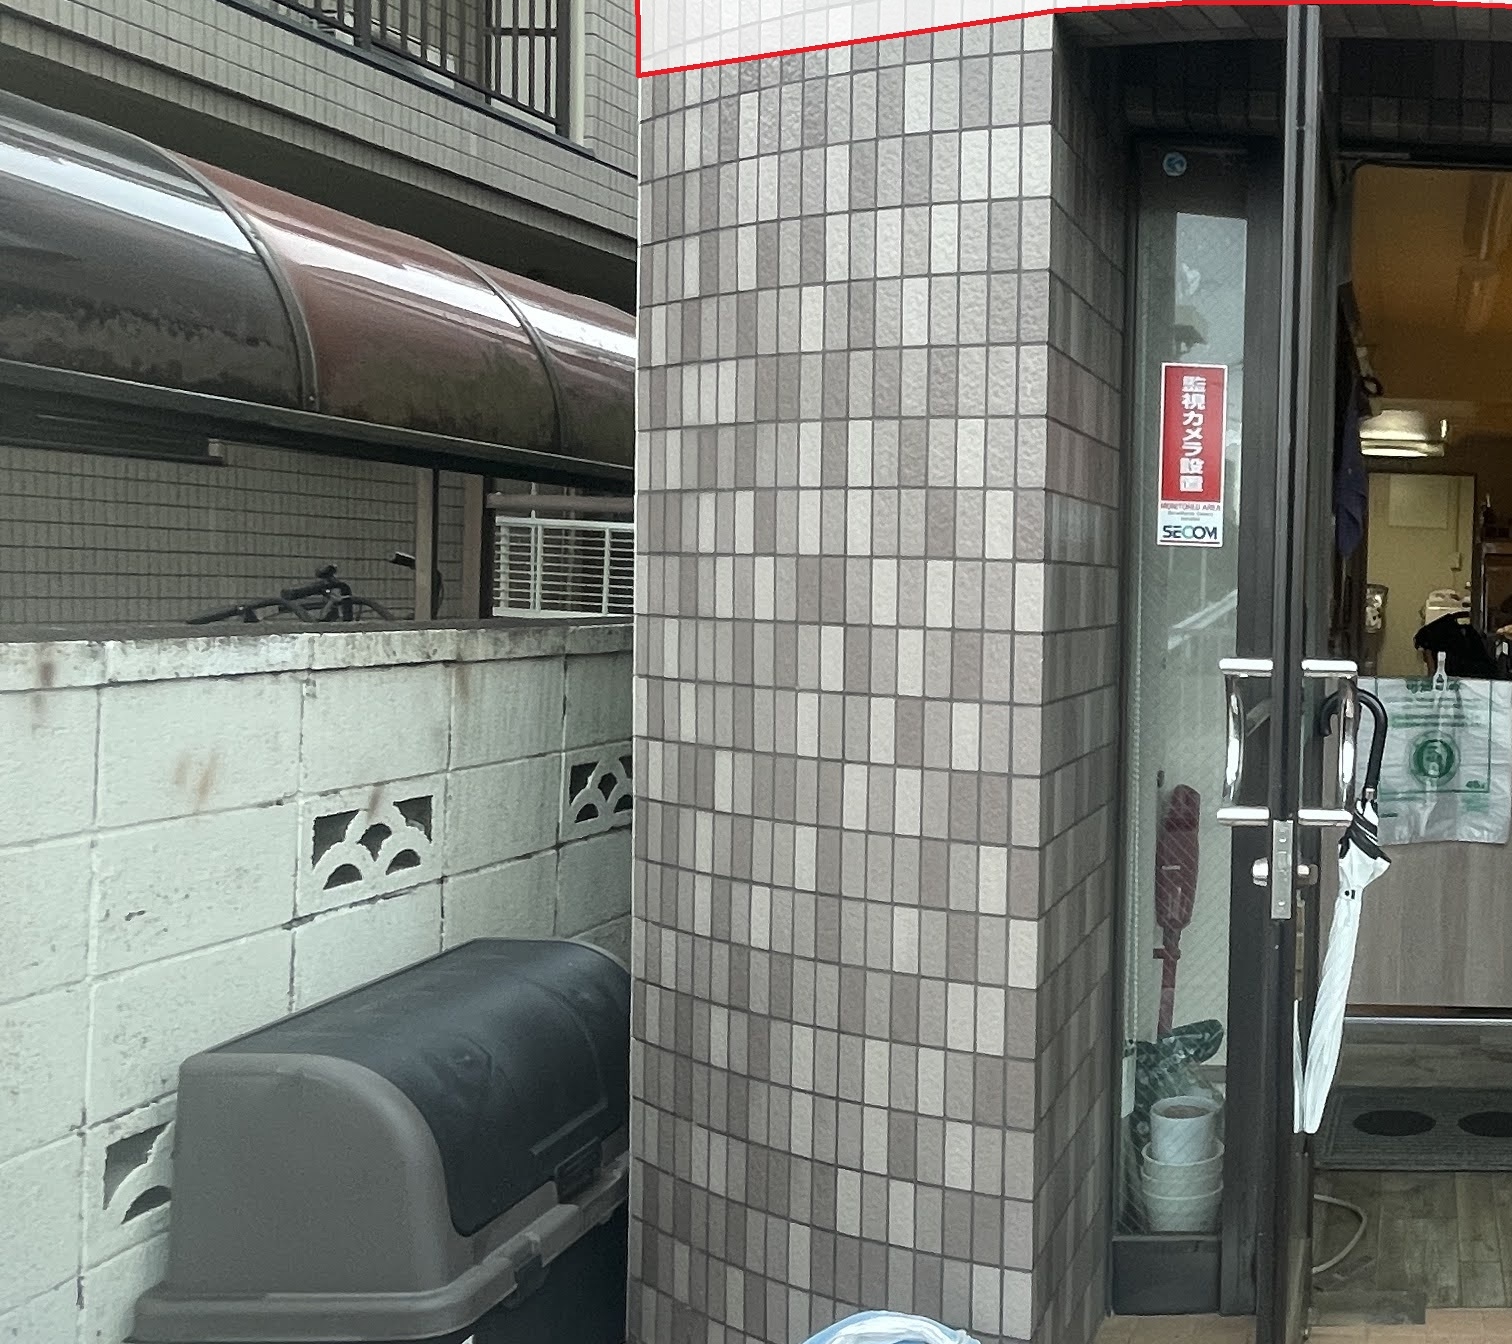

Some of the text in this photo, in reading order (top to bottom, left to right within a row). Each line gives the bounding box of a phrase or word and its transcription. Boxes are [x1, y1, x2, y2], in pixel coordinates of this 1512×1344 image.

[1180, 375, 1207, 492] 監視カメラ設置
[1163, 525, 1218, 540] SECOM
